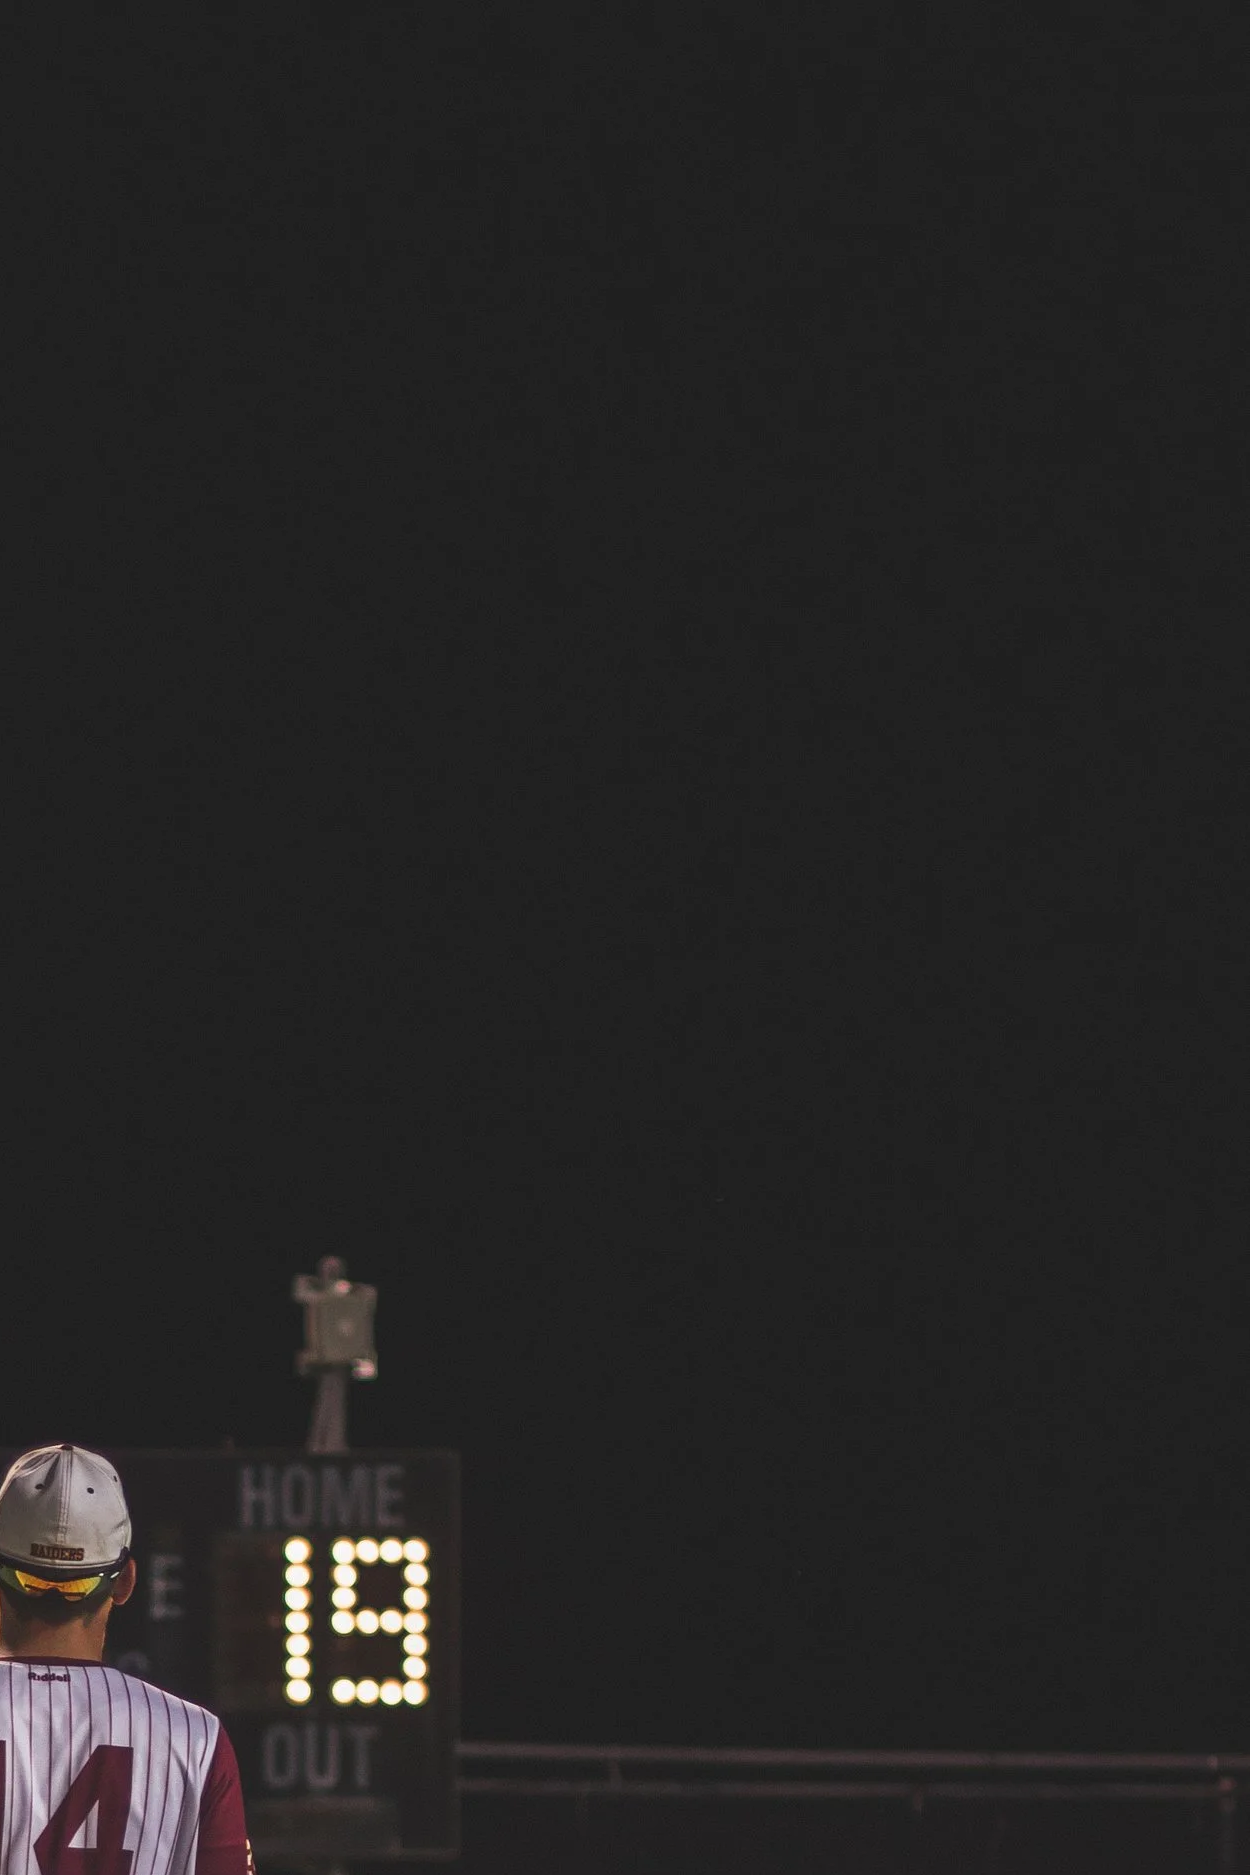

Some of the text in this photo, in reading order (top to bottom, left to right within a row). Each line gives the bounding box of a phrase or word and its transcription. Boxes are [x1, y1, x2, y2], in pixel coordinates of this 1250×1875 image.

[239, 1464, 406, 1528] HOME
[29, 1543, 85, 1561] RAIDERS
[284, 1536, 431, 1706] 19
[28, 1672, 71, 1682] Riddell
[262, 1722, 377, 1789] OUT
